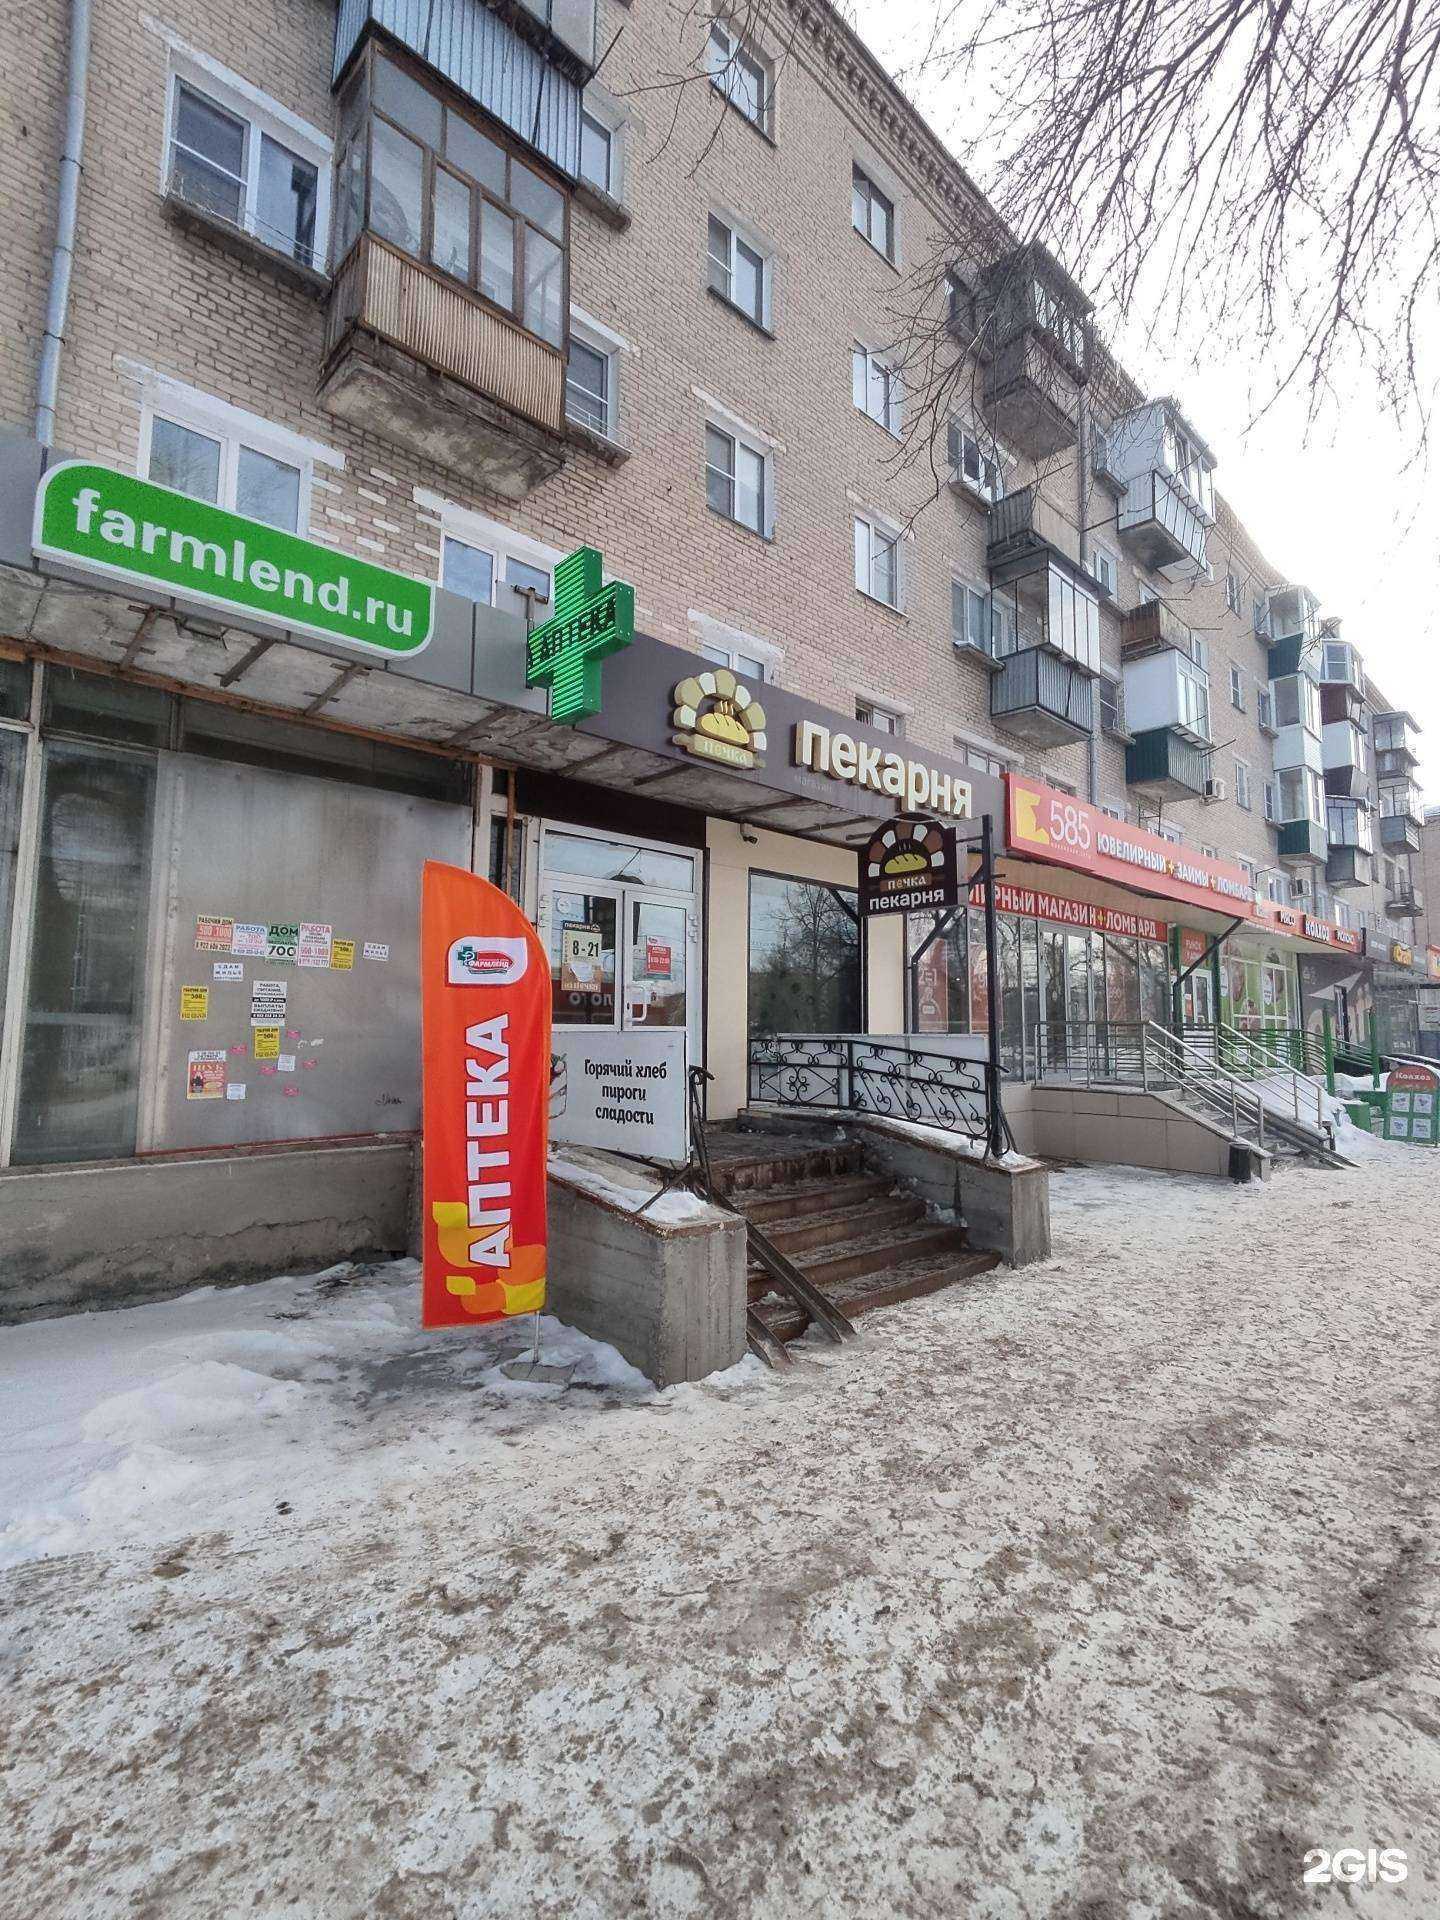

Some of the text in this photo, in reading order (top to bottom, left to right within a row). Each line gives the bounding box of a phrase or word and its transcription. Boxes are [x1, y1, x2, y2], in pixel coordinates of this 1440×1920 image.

[73, 488, 413, 637] farmlend.ru
[540, 596, 616, 660] АПТЕКА
[799, 719, 973, 819] пекарня
[1050, 799, 1091, 850] 585
[887, 876, 927, 891] печка
[869, 888, 945, 911] пекарня
[1038, 894, 1097, 924] МАГАЗИН
[1105, 911, 1157, 938] ЛОМБАРД
[269, 925, 299, 937] ДОМ
[300, 924, 331, 934] РАБОТА
[572, 940, 583, 956] 8
[587, 941, 600, 958] 21
[584, 1058, 667, 1079] Горячий хлеб
[602, 1085, 647, 1103] пироги
[595, 1106, 654, 1125] сладости
[464, 1012, 512, 1269] АПТЕКА
